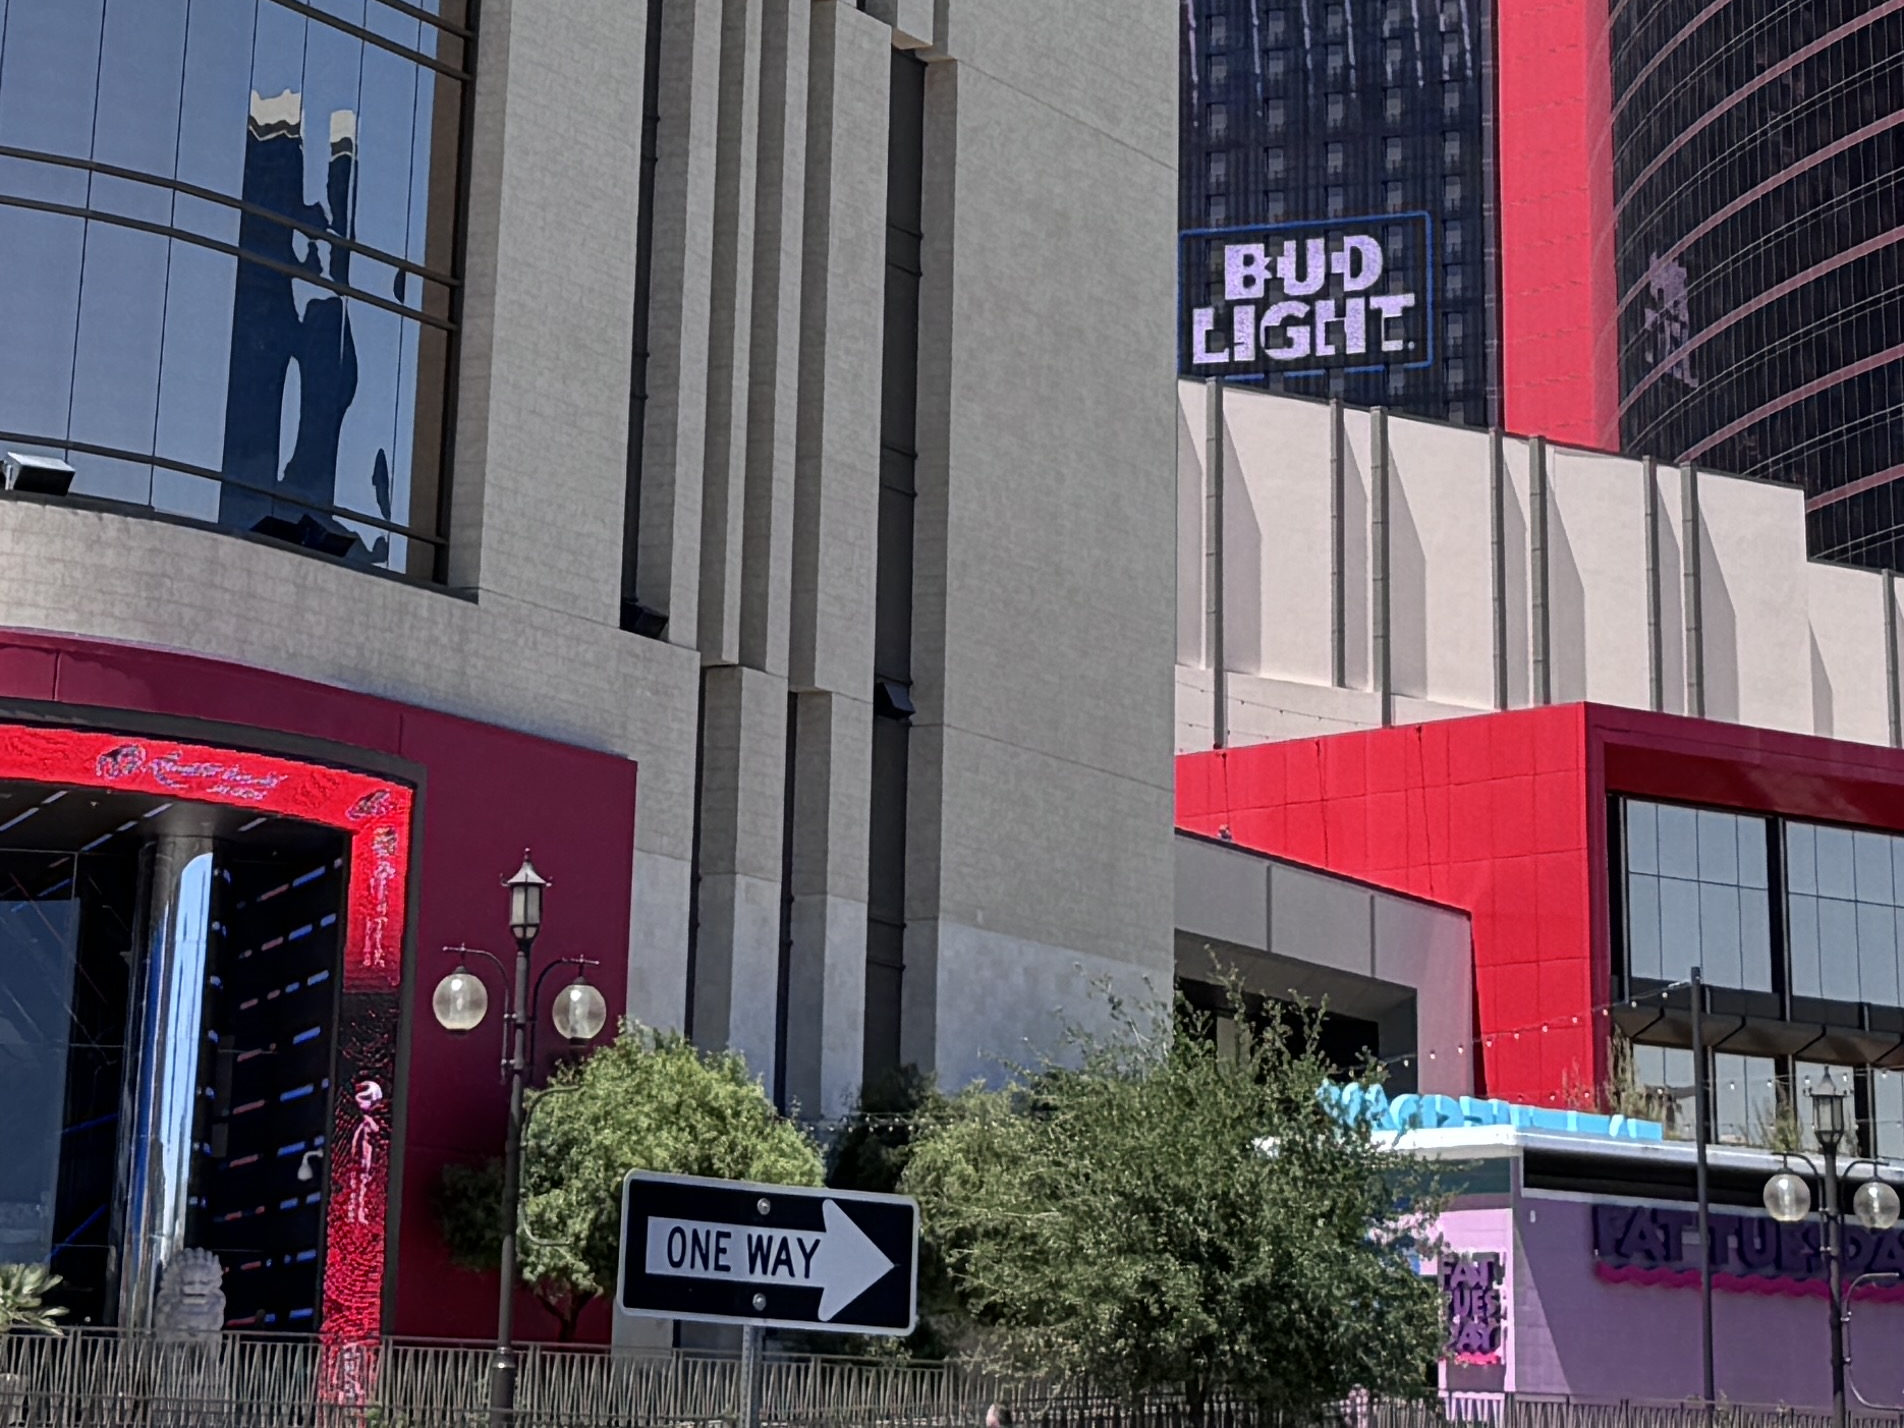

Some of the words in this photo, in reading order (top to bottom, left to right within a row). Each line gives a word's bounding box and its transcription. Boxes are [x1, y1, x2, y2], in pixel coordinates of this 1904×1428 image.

[1224, 234, 1384, 301] BUD
[667, 1225, 732, 1273] ONE
[747, 1233, 822, 1280] WAY
[1594, 1204, 1698, 1263] FAT
